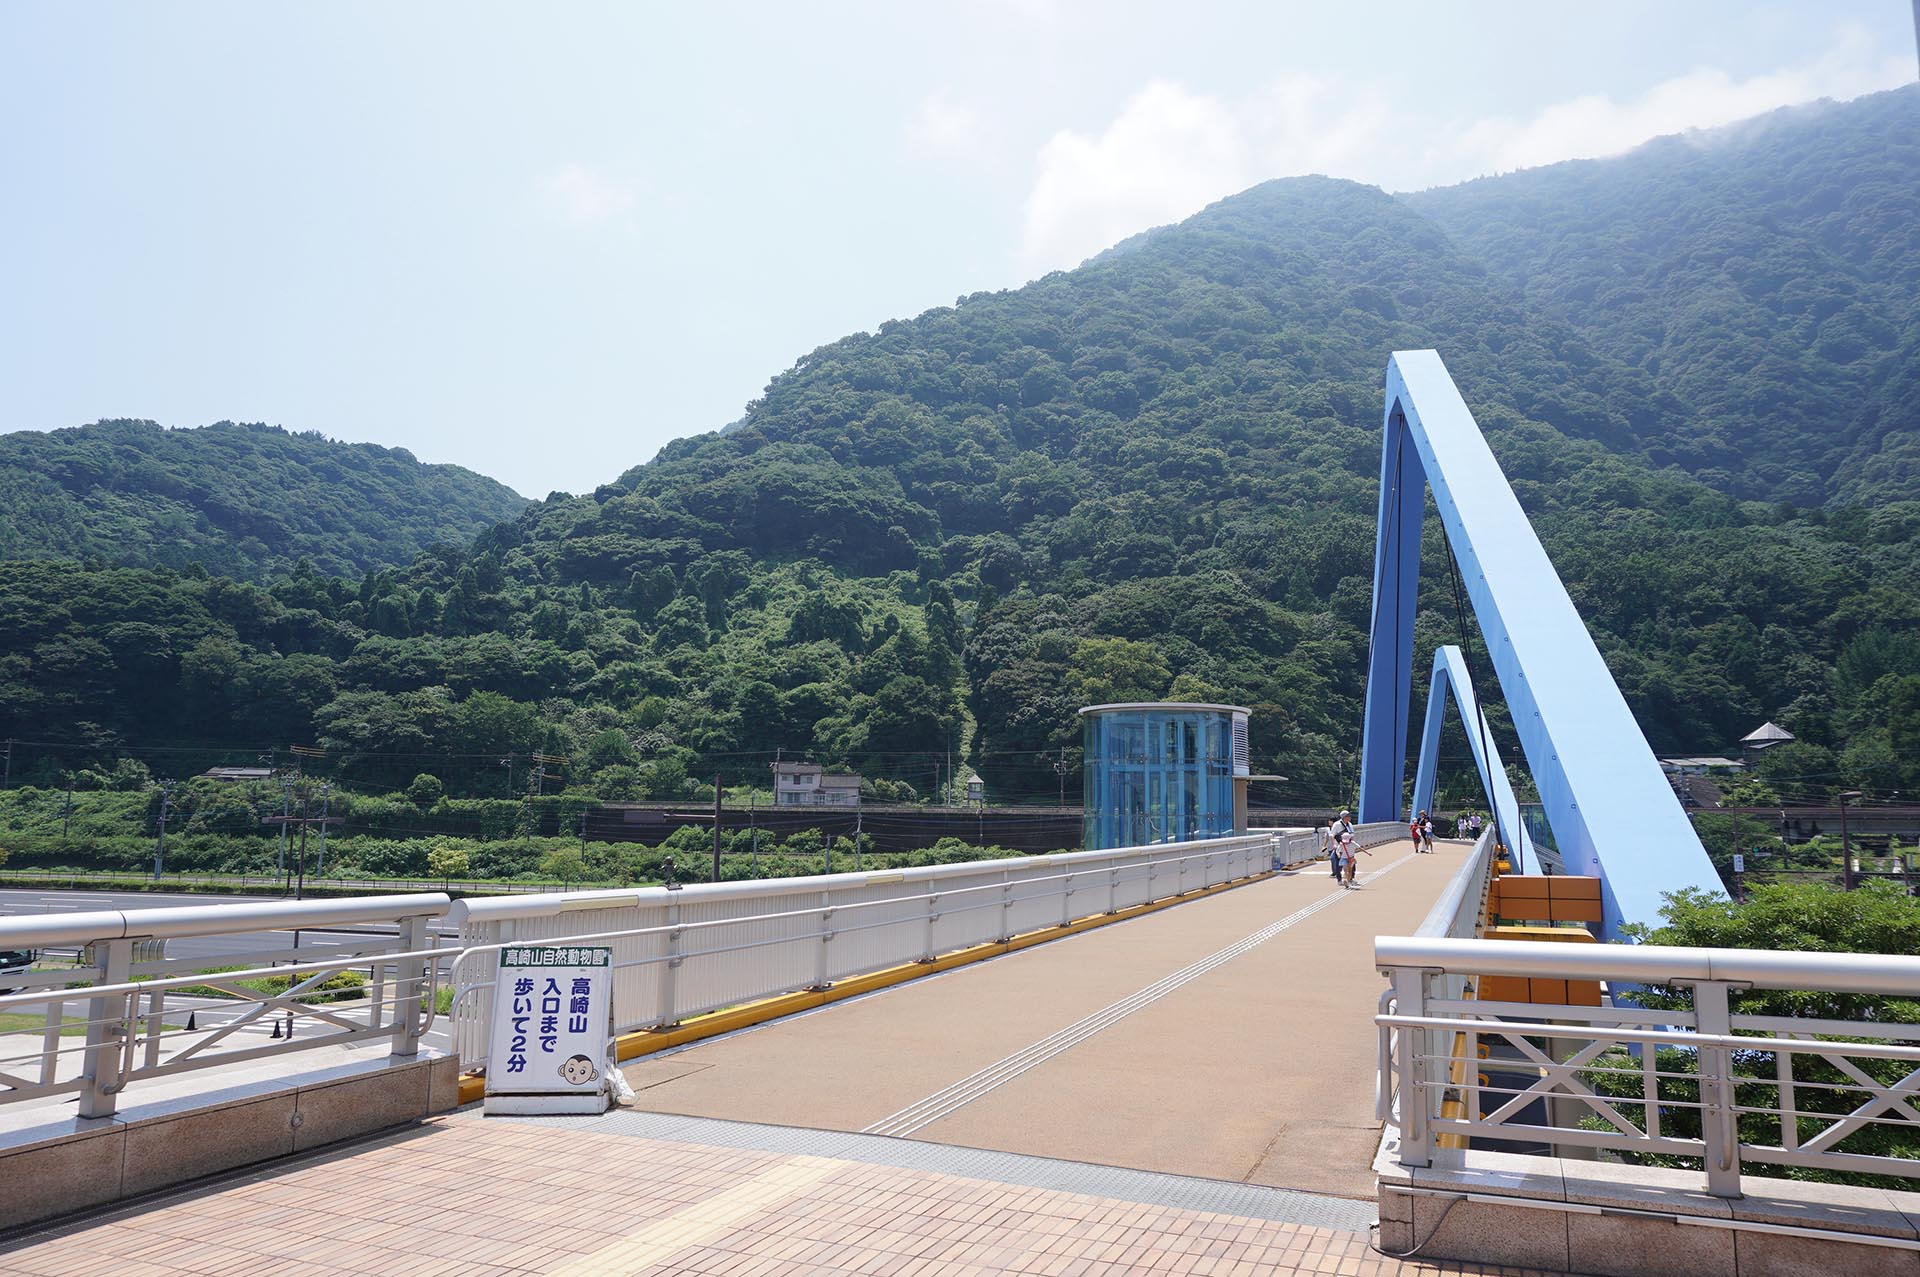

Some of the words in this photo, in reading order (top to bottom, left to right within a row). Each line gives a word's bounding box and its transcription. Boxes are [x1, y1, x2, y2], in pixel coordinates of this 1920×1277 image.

[505, 949, 605, 966] 高崎山自然動物園
[507, 977, 534, 1073] 歩いて2分
[539, 977, 562, 1053] 入口まで
[568, 977, 591, 1034] 高崎山
